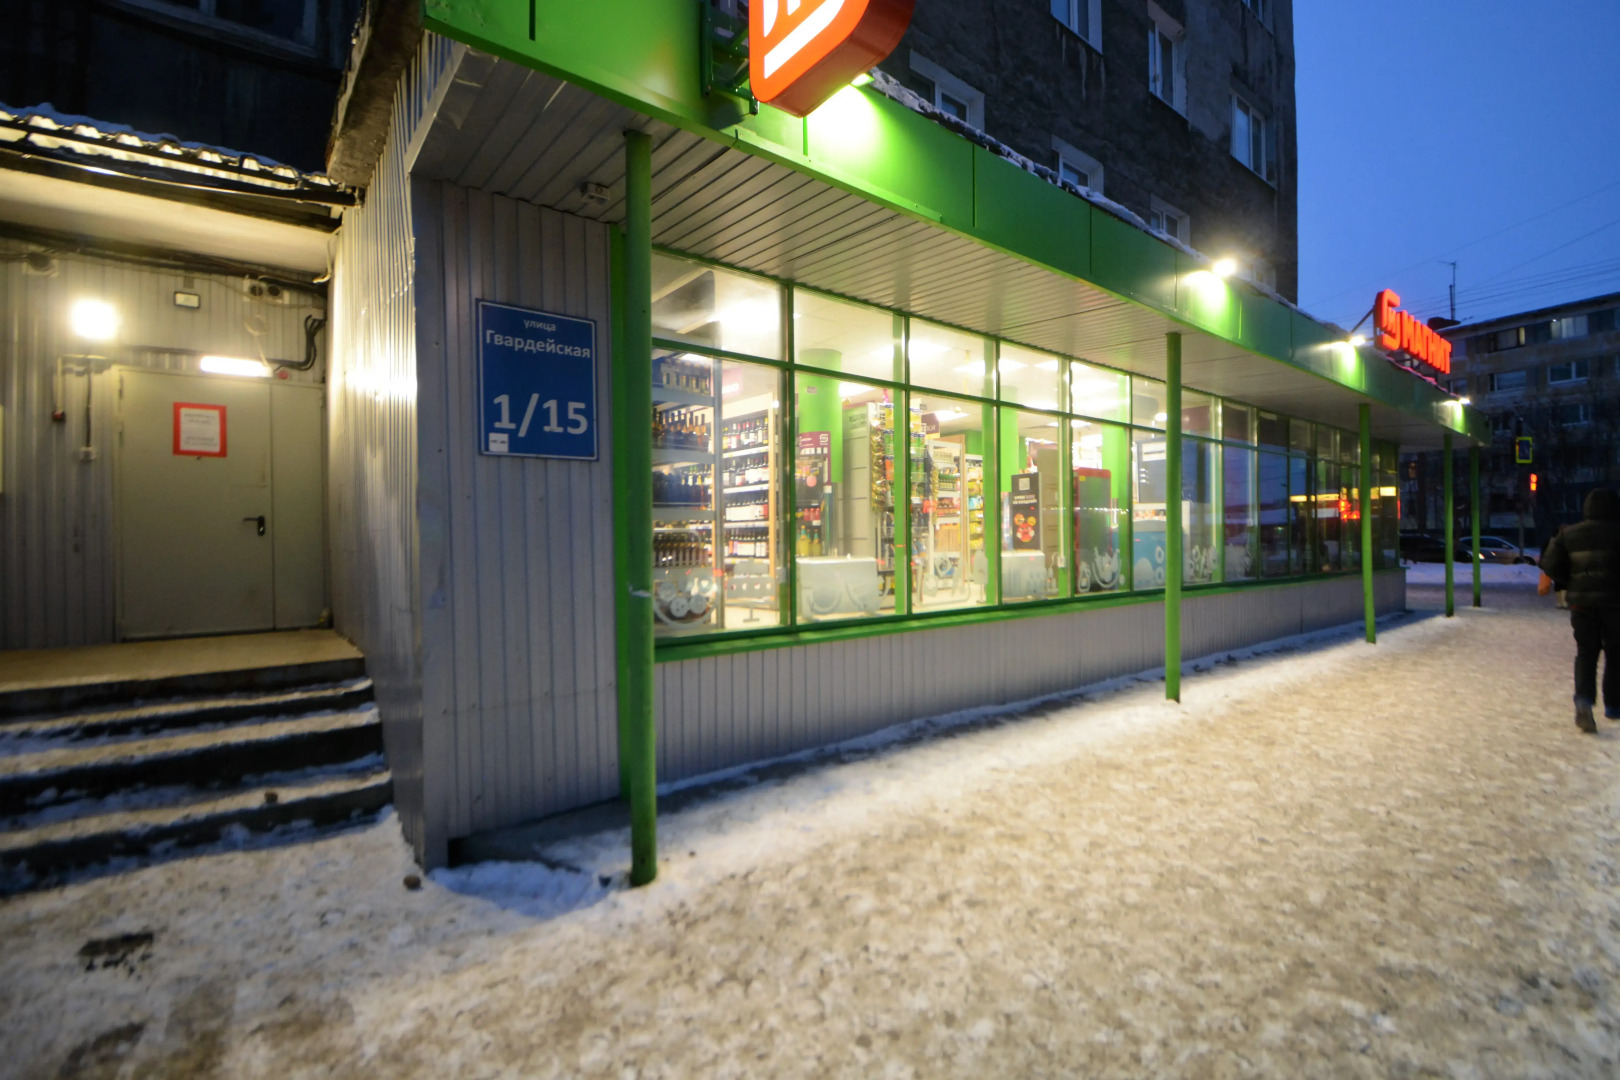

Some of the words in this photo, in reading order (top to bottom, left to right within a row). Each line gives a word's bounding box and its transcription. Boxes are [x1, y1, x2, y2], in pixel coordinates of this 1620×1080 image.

[524, 319, 556, 331] улица
[1402, 310, 1451, 374] МАГНИТ
[486, 330, 590, 358] Гвардейская
[493, 393, 588, 437] 1/15
